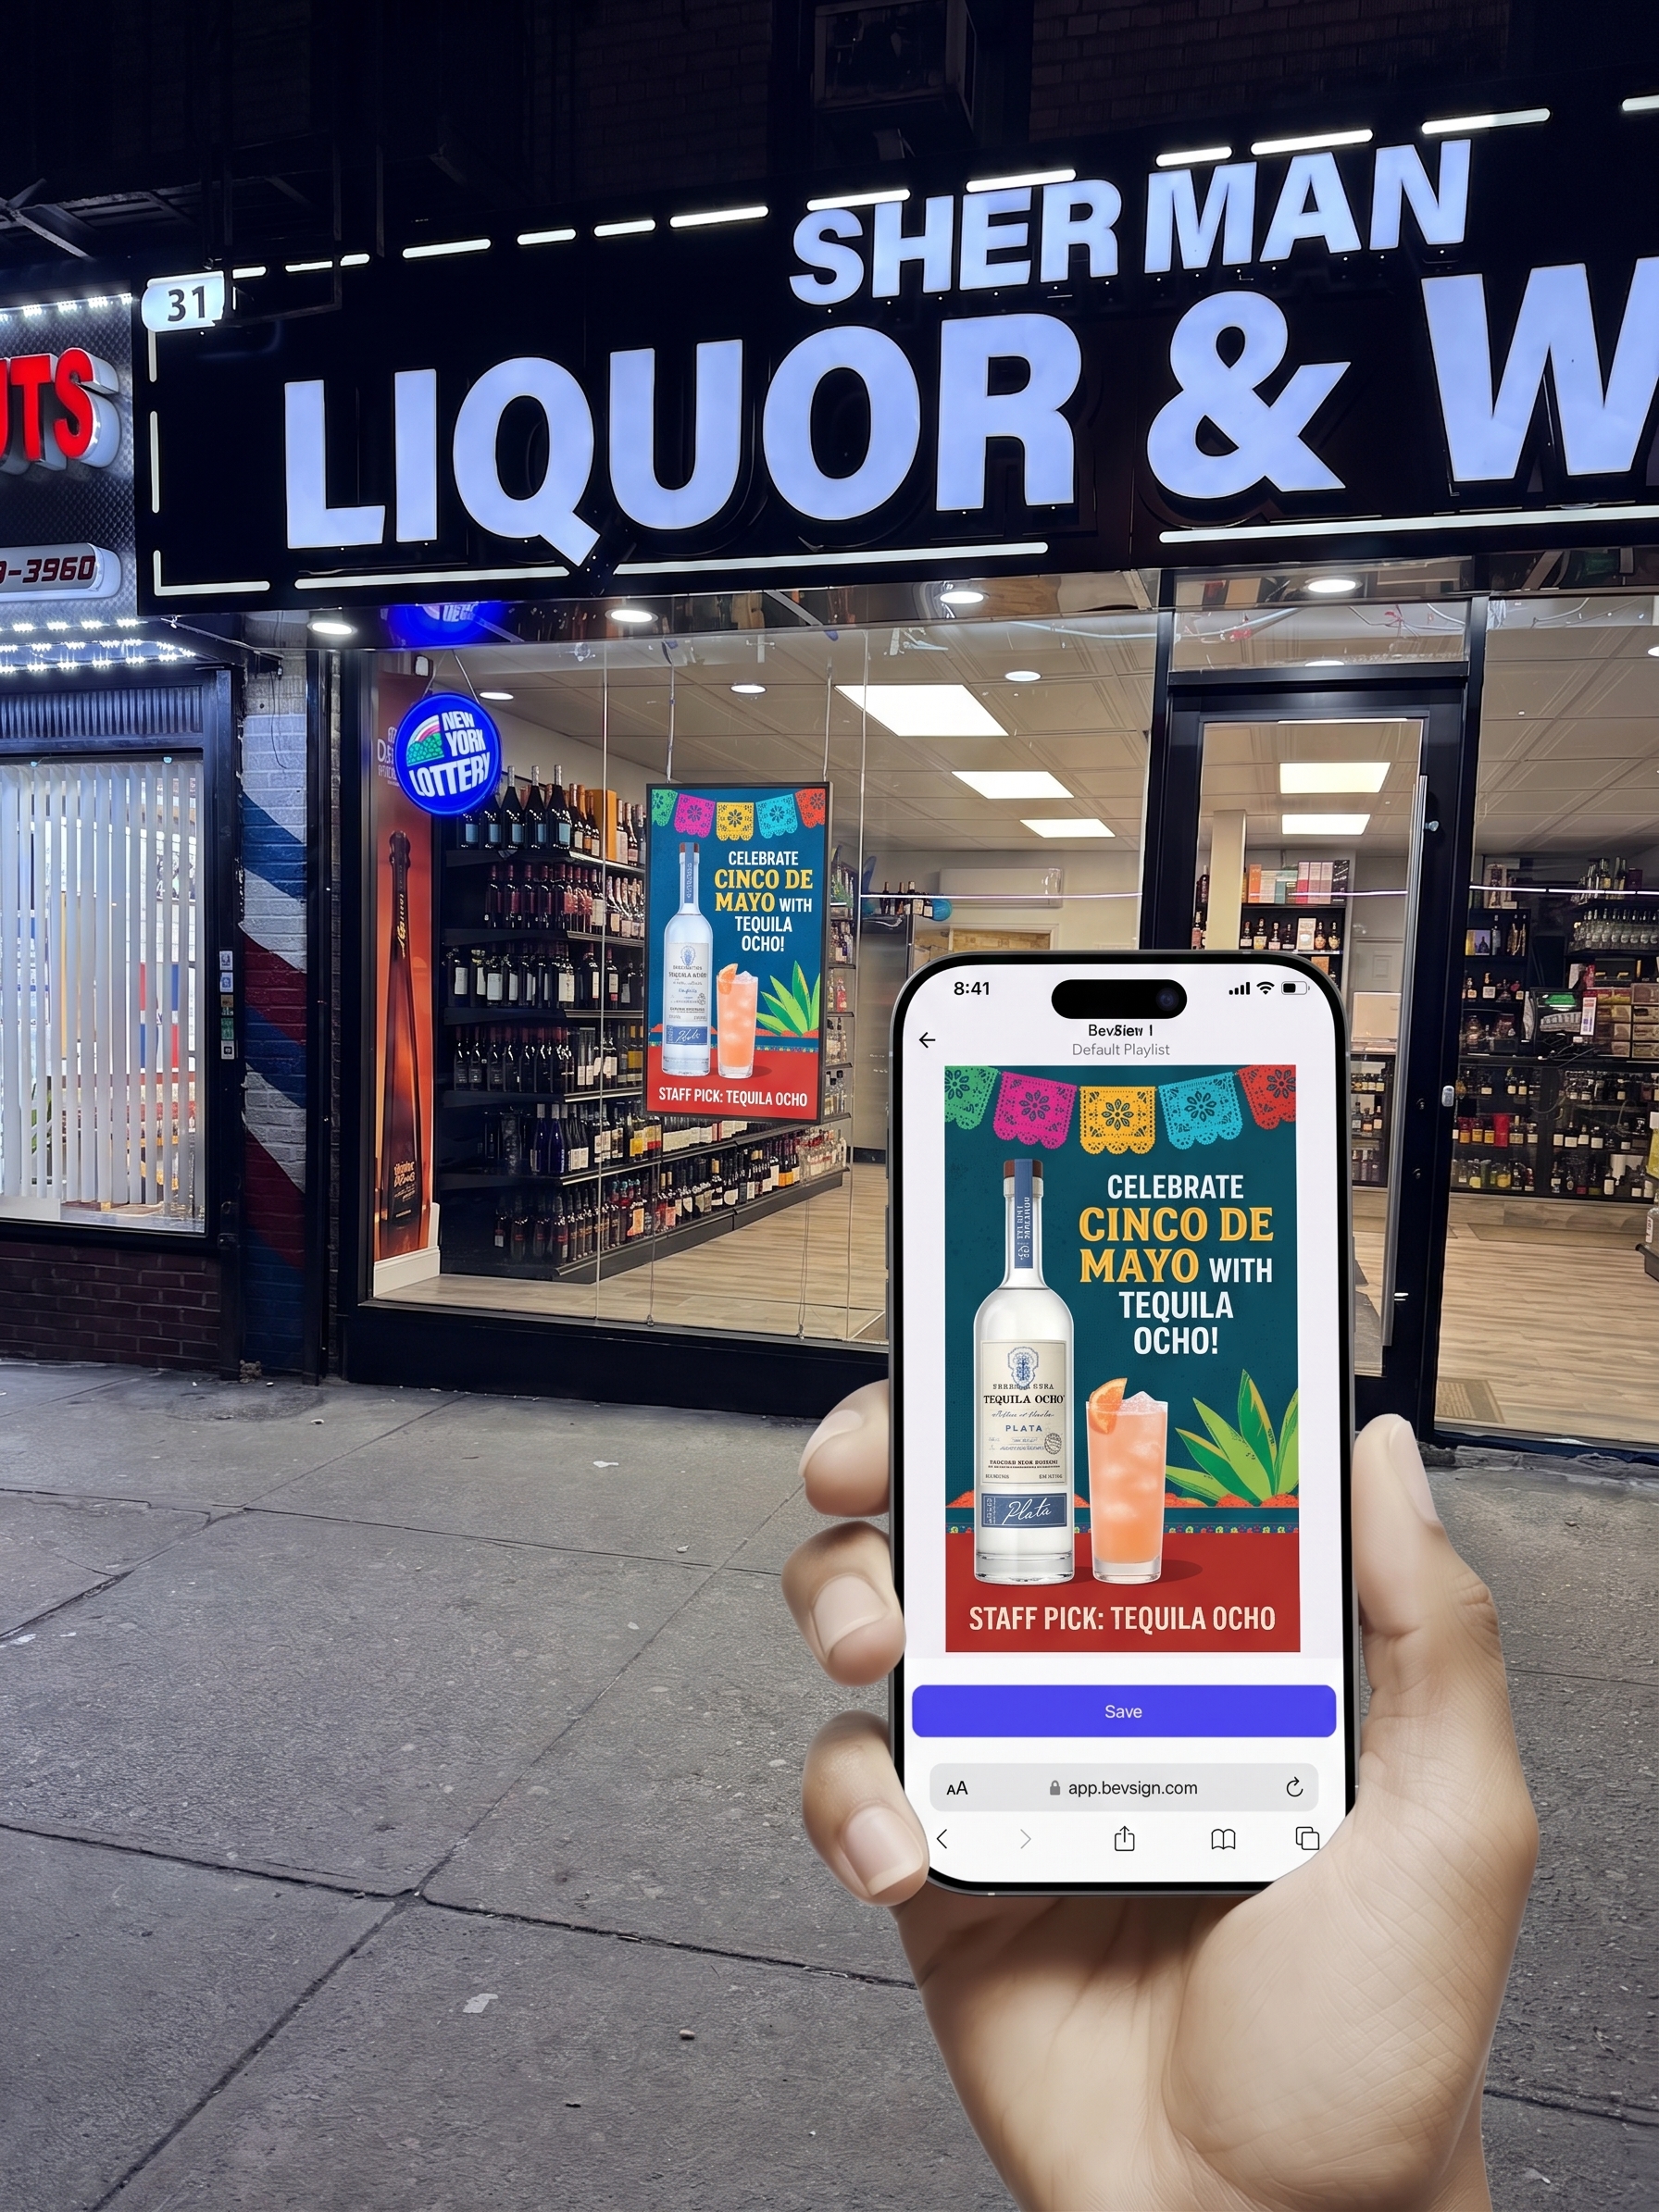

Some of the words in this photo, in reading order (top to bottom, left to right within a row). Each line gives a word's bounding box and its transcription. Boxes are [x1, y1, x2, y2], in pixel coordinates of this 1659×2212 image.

[167, 285, 207, 322] 31
[0, 347, 94, 460] TS
[284, 313, 1082, 566] LIQUOR
[1147, 290, 1352, 500] &
[442, 711, 475, 731] NEW
[445, 728, 487, 757] YORK
[408, 752, 491, 798] LOTTERY
[729, 851, 799, 866] CELEBRATE
[714, 868, 780, 889] CINCO
[784, 869, 813, 889] DE
[715, 892, 776, 913] MAYO
[779, 898, 813, 913] WITH
[735, 915, 792, 934] TEQUILA
[742, 935, 785, 952] OCHO!
[954, 981, 991, 996] 8:41
[1072, 1043, 1120, 1056] Default
[1124, 1043, 1170, 1059] Playlist
[658, 1087, 692, 1102] STAFF
[694, 1088, 723, 1103] PICK:
[726, 1090, 773, 1108] TEQUILA
[776, 1092, 808, 1107] OCHO
[1107, 1174, 1244, 1199] CELEBRATE
[1079, 1206, 1208, 1242] CINCO
[1219, 1207, 1275, 1242] DE
[1080, 1248, 1200, 1284] MAYO
[1209, 1258, 1273, 1283] WITH
[1118, 1291, 1234, 1323] TEQUILA
[1134, 1326, 1219, 1355] OCHO!
[983, 1394, 1031, 1406] TEQUILA
[1034, 1394, 1064, 1404] OCHO
[1002, 1497, 1052, 1525] Plata
[969, 1606, 1038, 1632] STAFF
[1044, 1606, 1104, 1632] PICK:
[1110, 1606, 1207, 1636] TEQUILA
[1213, 1607, 1276, 1632] OCHO
[1104, 1705, 1143, 1719] Save
[1068, 1780, 1198, 1798] app.bevsign.com
